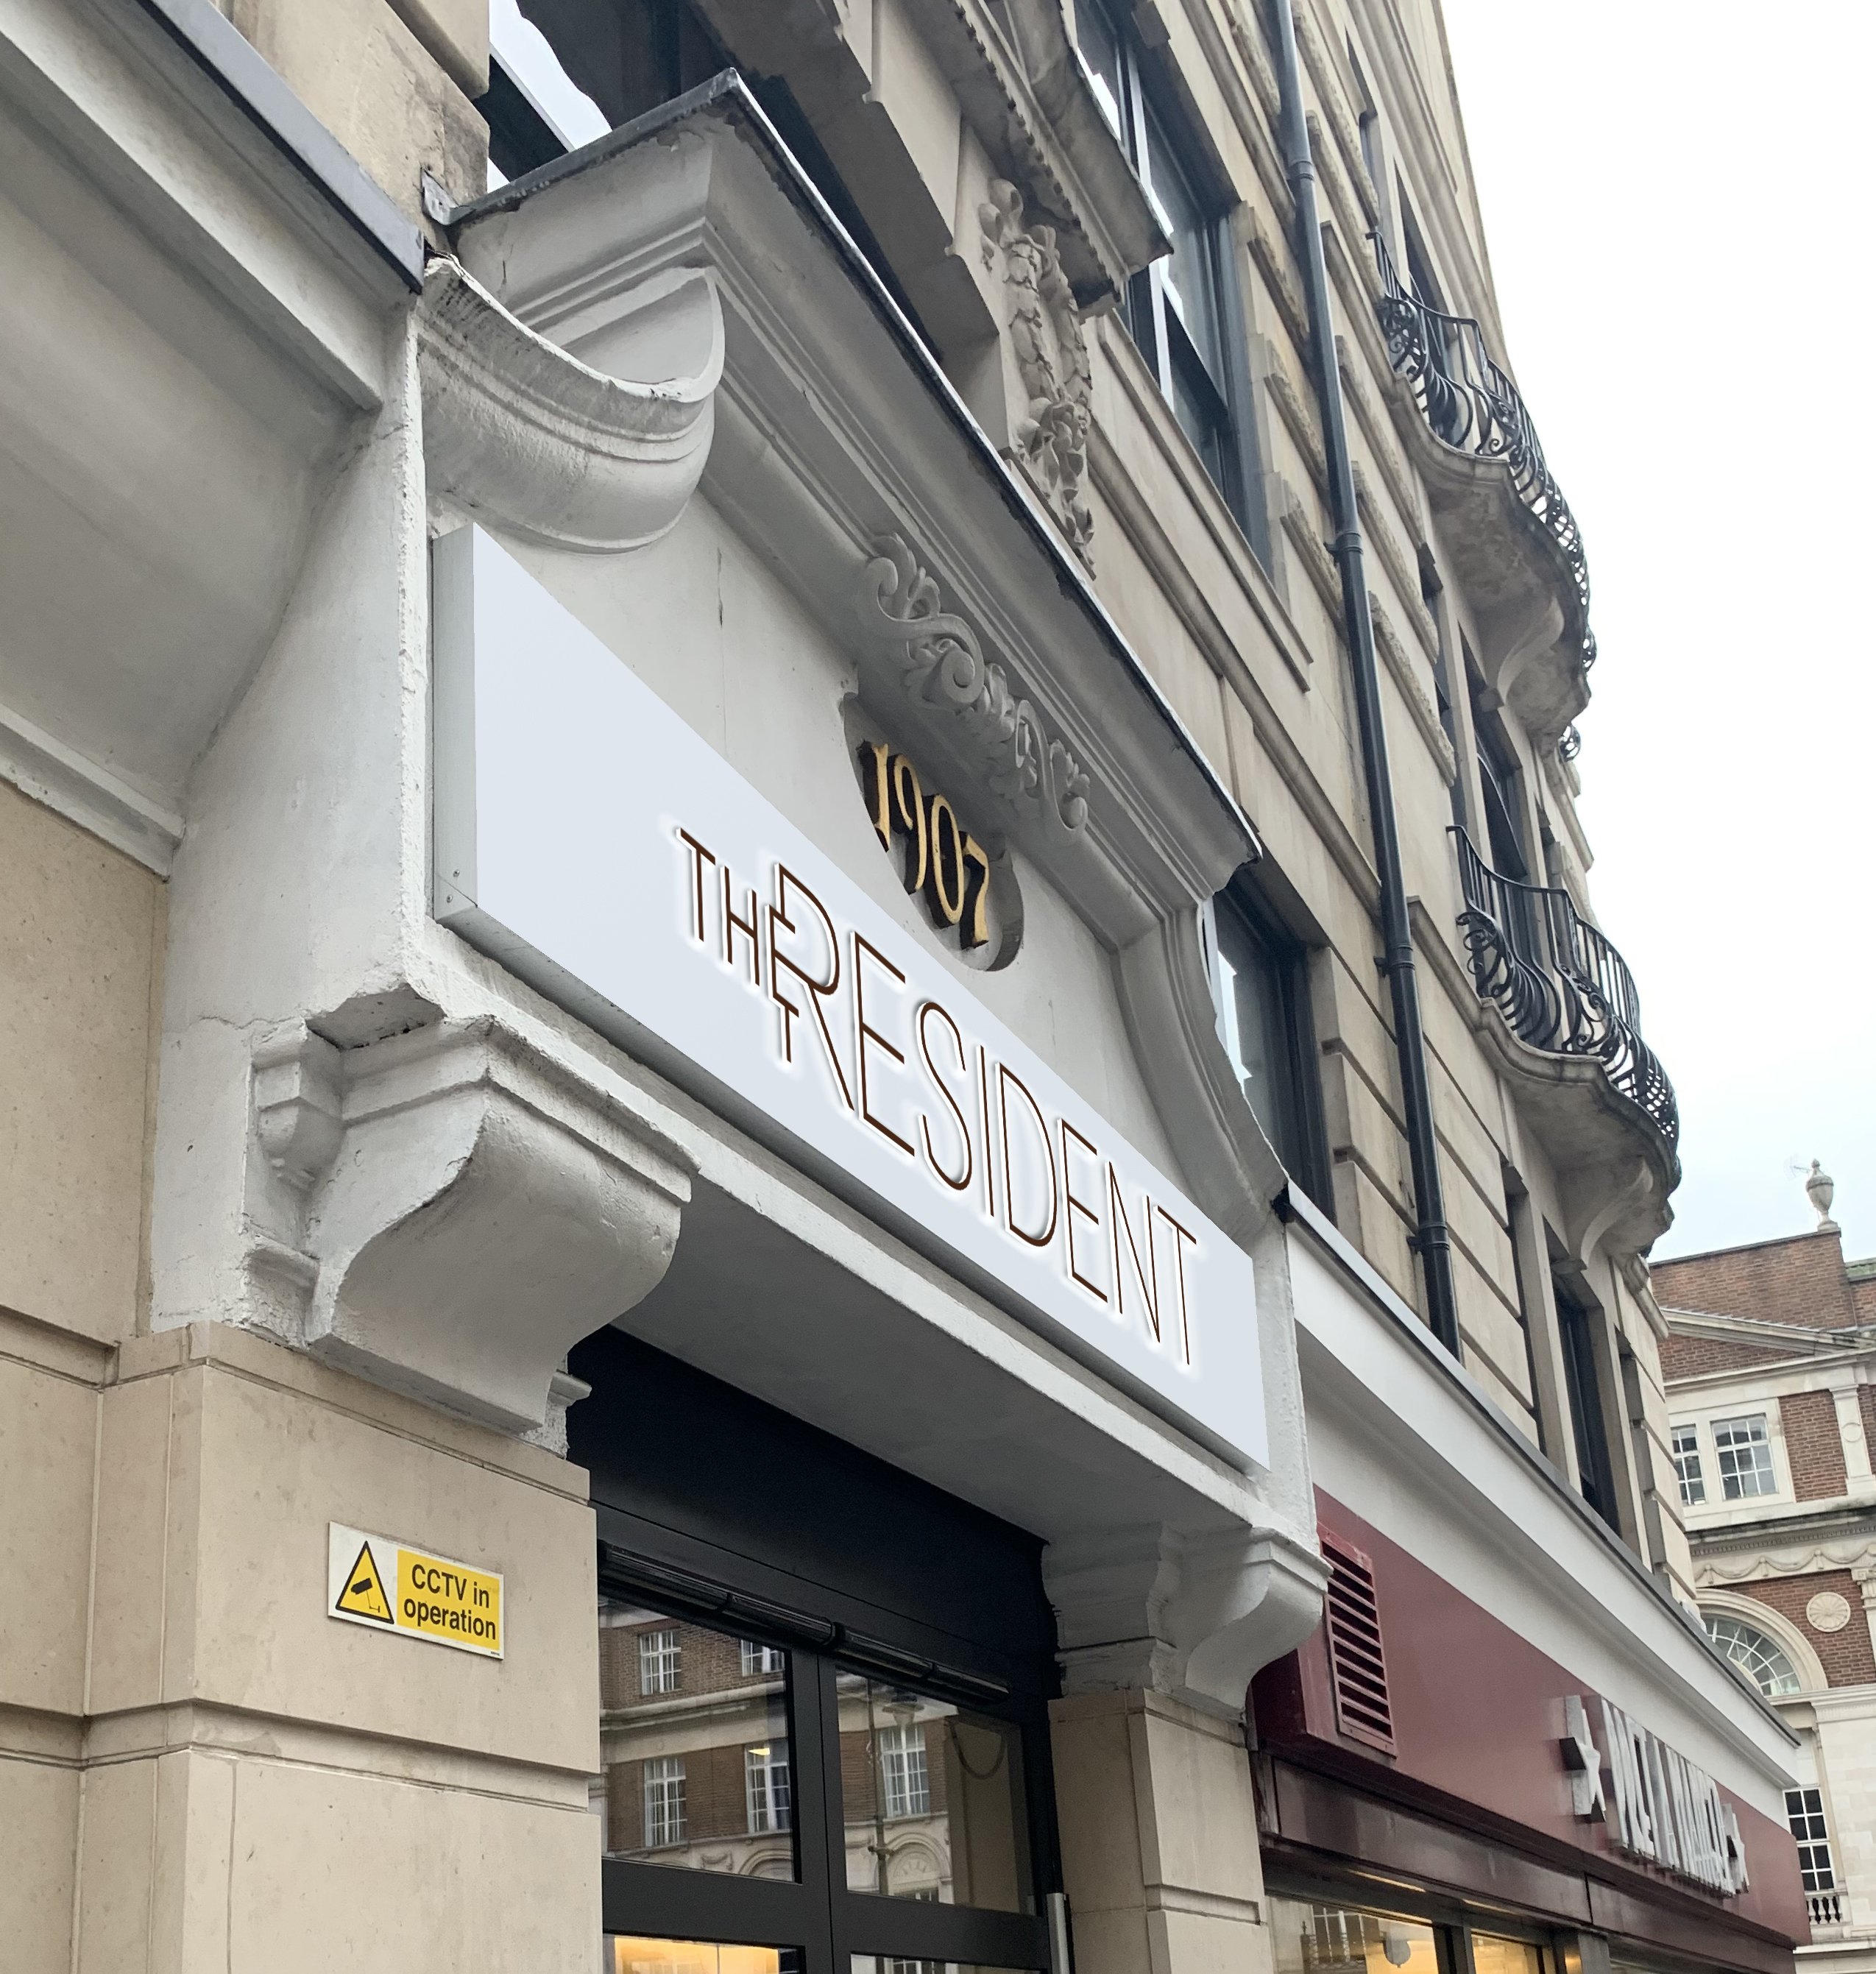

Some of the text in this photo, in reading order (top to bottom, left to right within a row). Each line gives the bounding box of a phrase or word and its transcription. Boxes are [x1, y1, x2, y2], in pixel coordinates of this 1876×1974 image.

[677, 827, 799, 1019] THE
[857, 739, 989, 949] 1907
[769, 863, 1197, 1366] RESIDENT
[404, 1599, 496, 1640] operation
[412, 1564, 489, 1608] CCTV in
